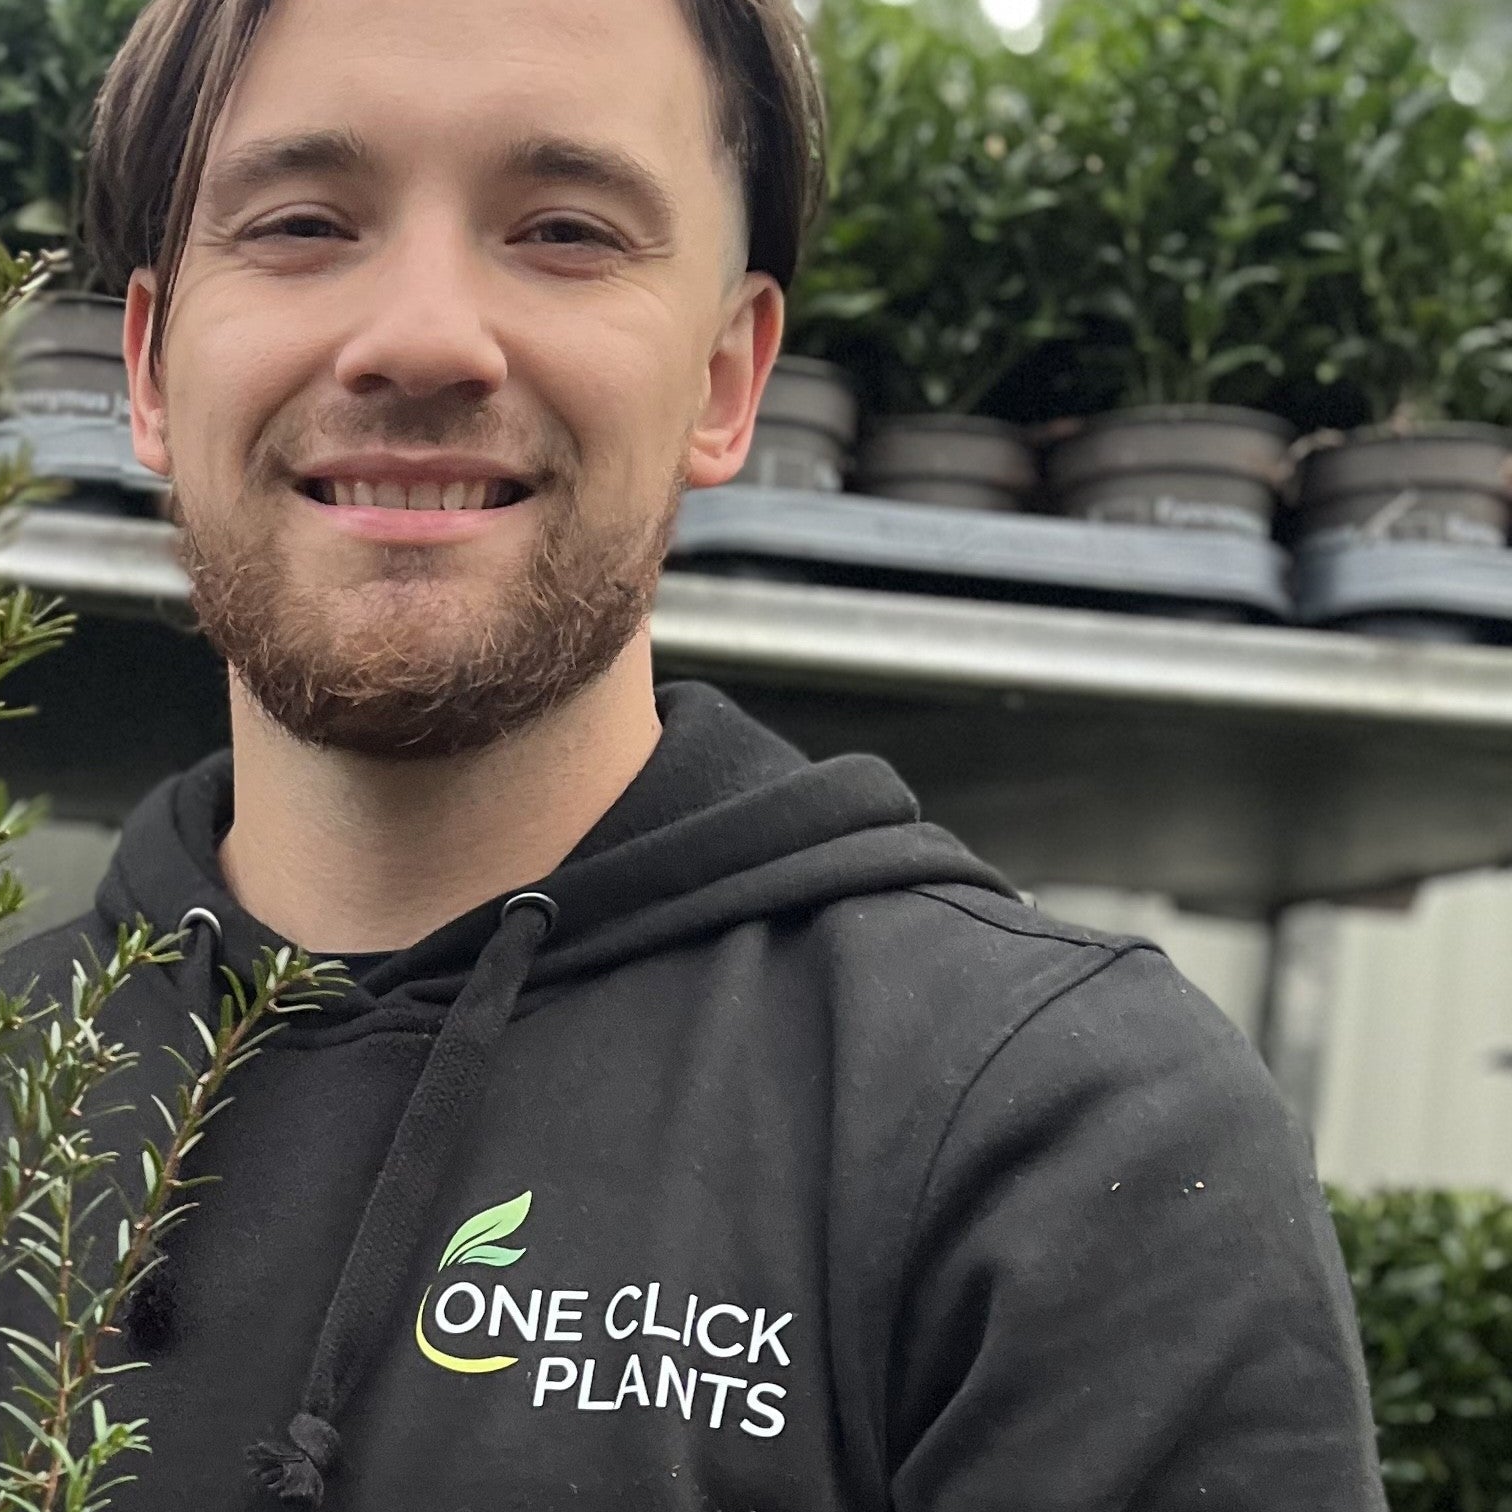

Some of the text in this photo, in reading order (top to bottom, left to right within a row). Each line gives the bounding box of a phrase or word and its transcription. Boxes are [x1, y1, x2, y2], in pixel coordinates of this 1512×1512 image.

[435, 1281, 793, 1366] ONE CLICK
[533, 1354, 787, 1437] PLANTS
